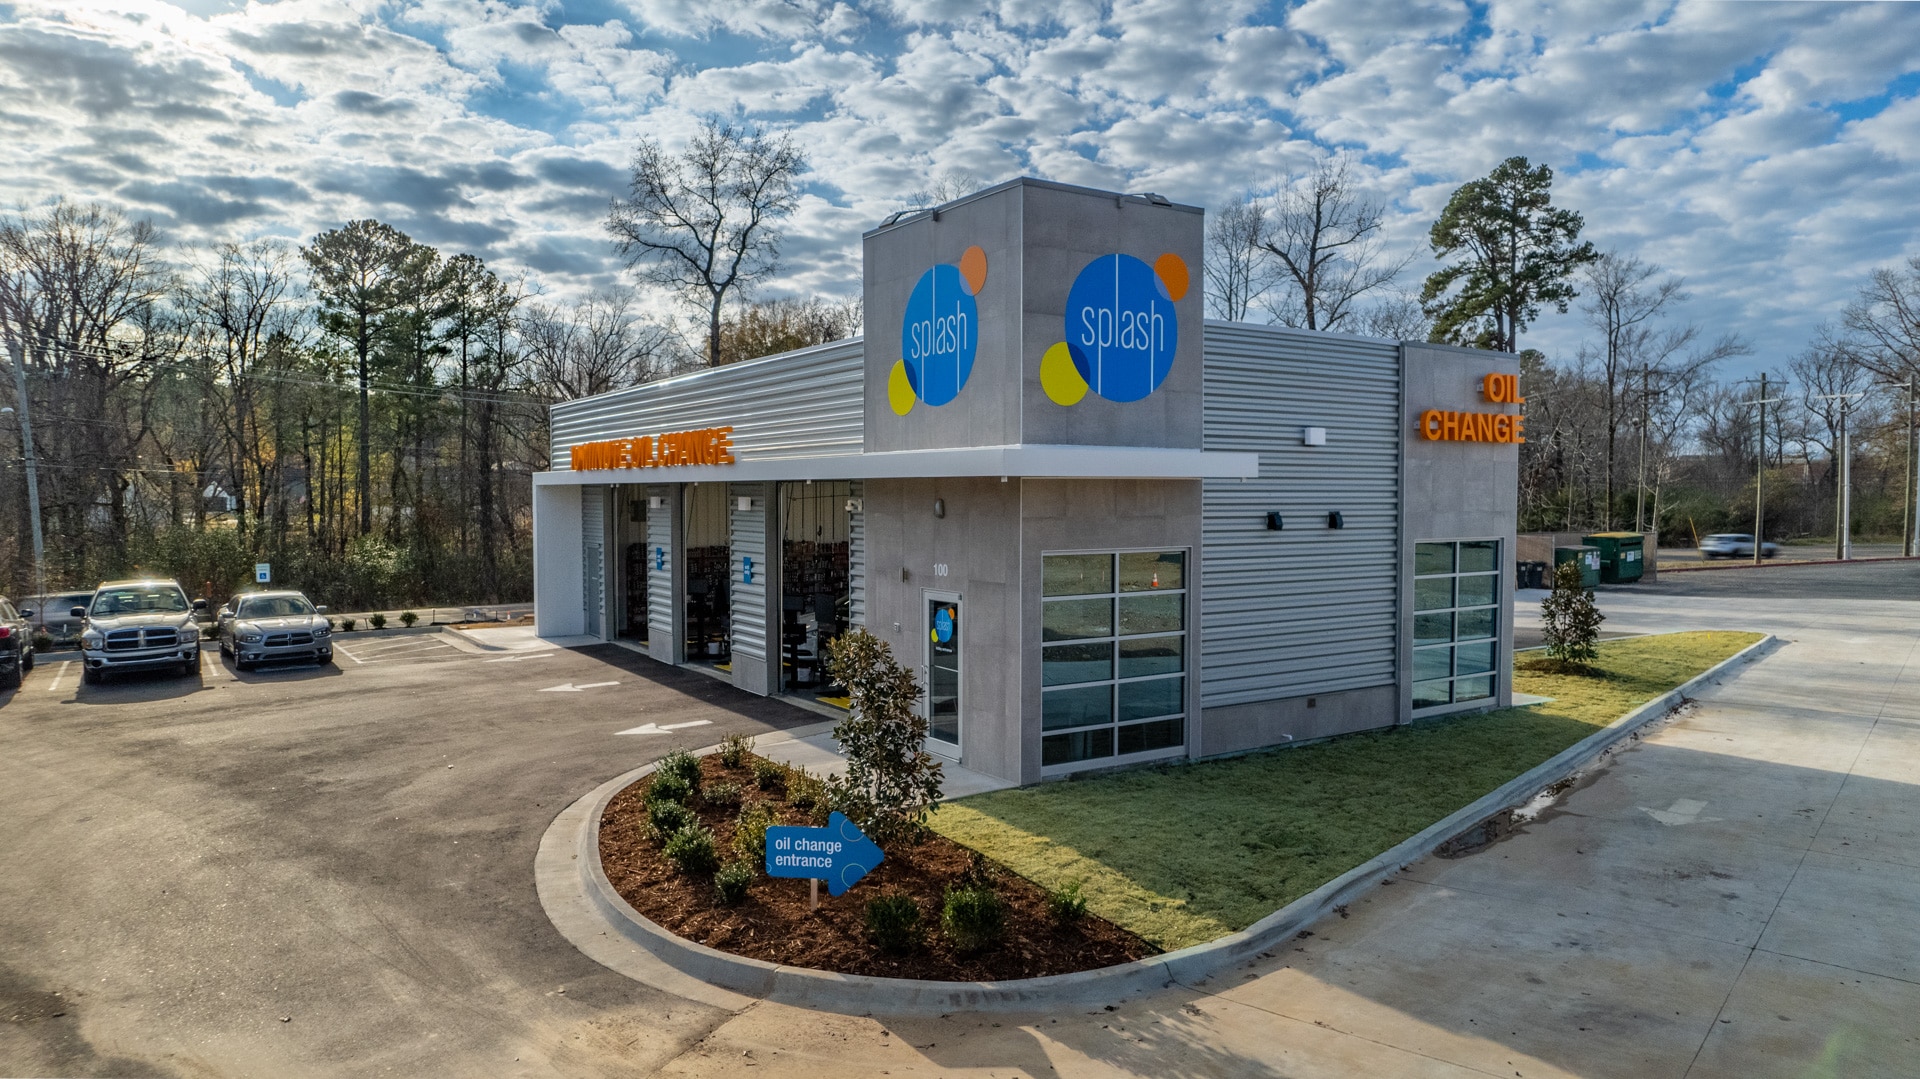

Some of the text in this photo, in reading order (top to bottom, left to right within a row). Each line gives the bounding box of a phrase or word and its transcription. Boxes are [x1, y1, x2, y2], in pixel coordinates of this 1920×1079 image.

[1484, 373, 1526, 404] OIL
[1420, 409, 1526, 444] CHANGE
[658, 426, 735, 468] CHANGE
[933, 563, 949, 577] 100
[775, 837, 842, 855] oil change
[775, 854, 832, 868] entrance
